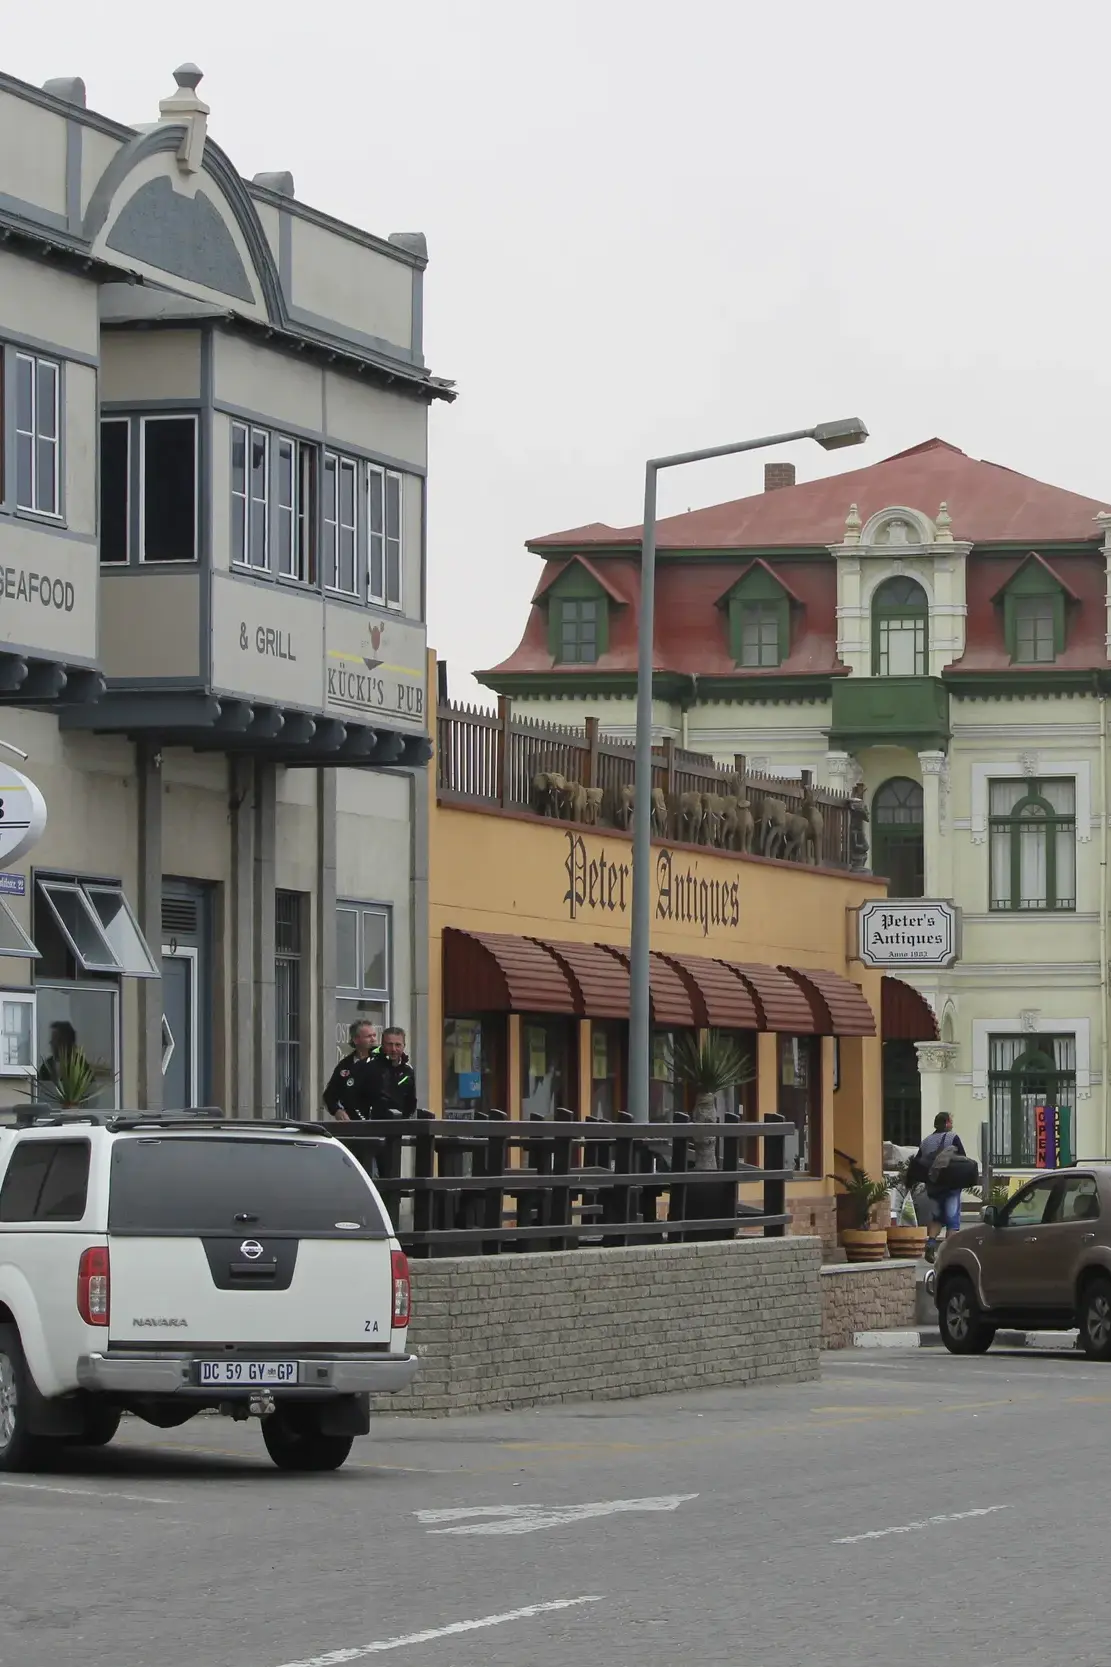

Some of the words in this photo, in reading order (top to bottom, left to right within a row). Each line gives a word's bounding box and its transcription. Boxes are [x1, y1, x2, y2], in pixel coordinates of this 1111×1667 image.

[239, 621, 249, 651] &
[256, 626, 297, 661] GRILL
[327, 662, 384, 705] KÜCKI'S
[397, 683, 423, 713] PUB
[563, 831, 634, 919] Peter'
[656, 849, 740, 938] Antiques
[881, 913, 936, 930] Peter's
[871, 931, 943, 947] Antiques
[888, 950, 908, 958] Anno
[1038, 1111, 1046, 1162] OPEN
[132, 1317, 189, 1328] NAVARA
[203, 1362, 220, 1380] DC
[226, 1362, 242, 1380] 59
[249, 1362, 265, 1380] GY
[277, 1362, 293, 1380] GP
